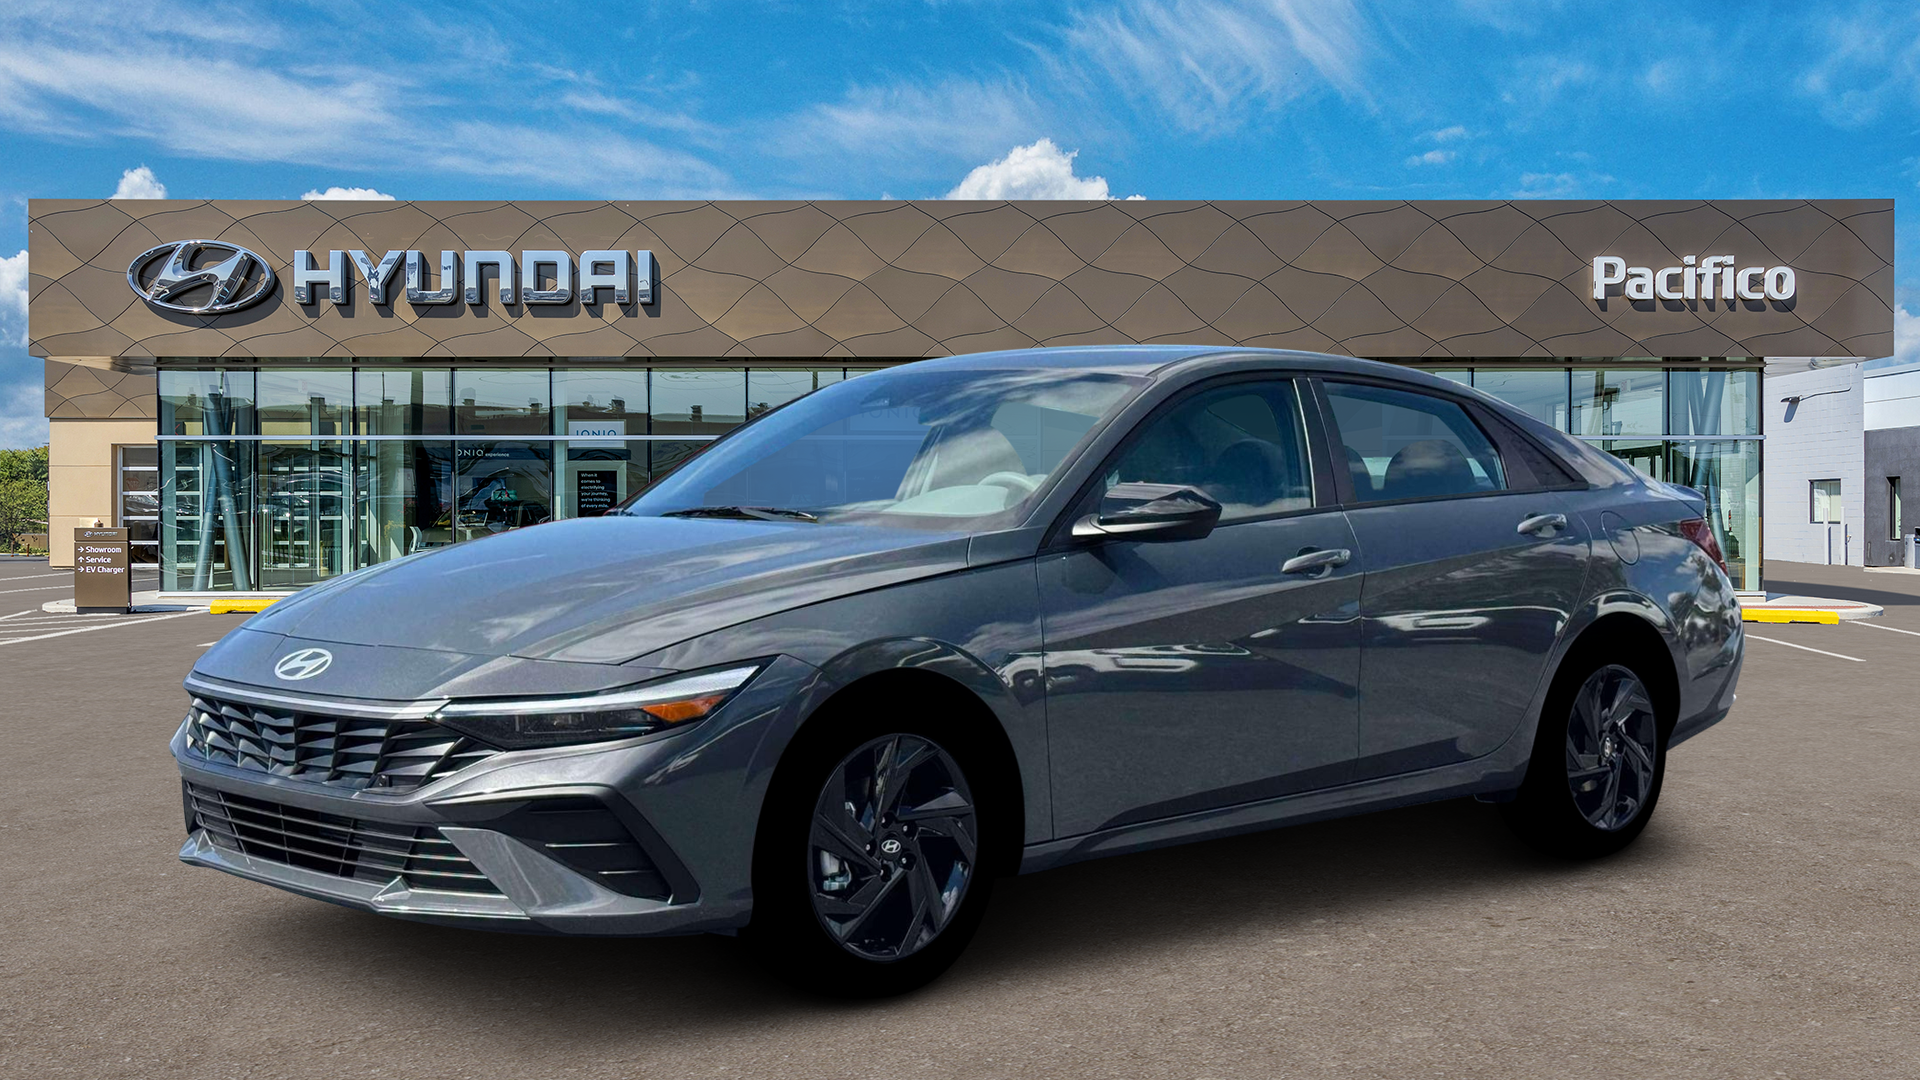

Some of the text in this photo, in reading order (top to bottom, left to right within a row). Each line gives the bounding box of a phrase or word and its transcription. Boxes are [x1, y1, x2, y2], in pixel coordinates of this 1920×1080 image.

[294, 250, 653, 304] HYUNDAI
[1593, 255, 1796, 300] Pacifico
[85, 546, 122, 554] Showroom
[85, 555, 112, 563] Service
[97, 566, 125, 575] Charger
